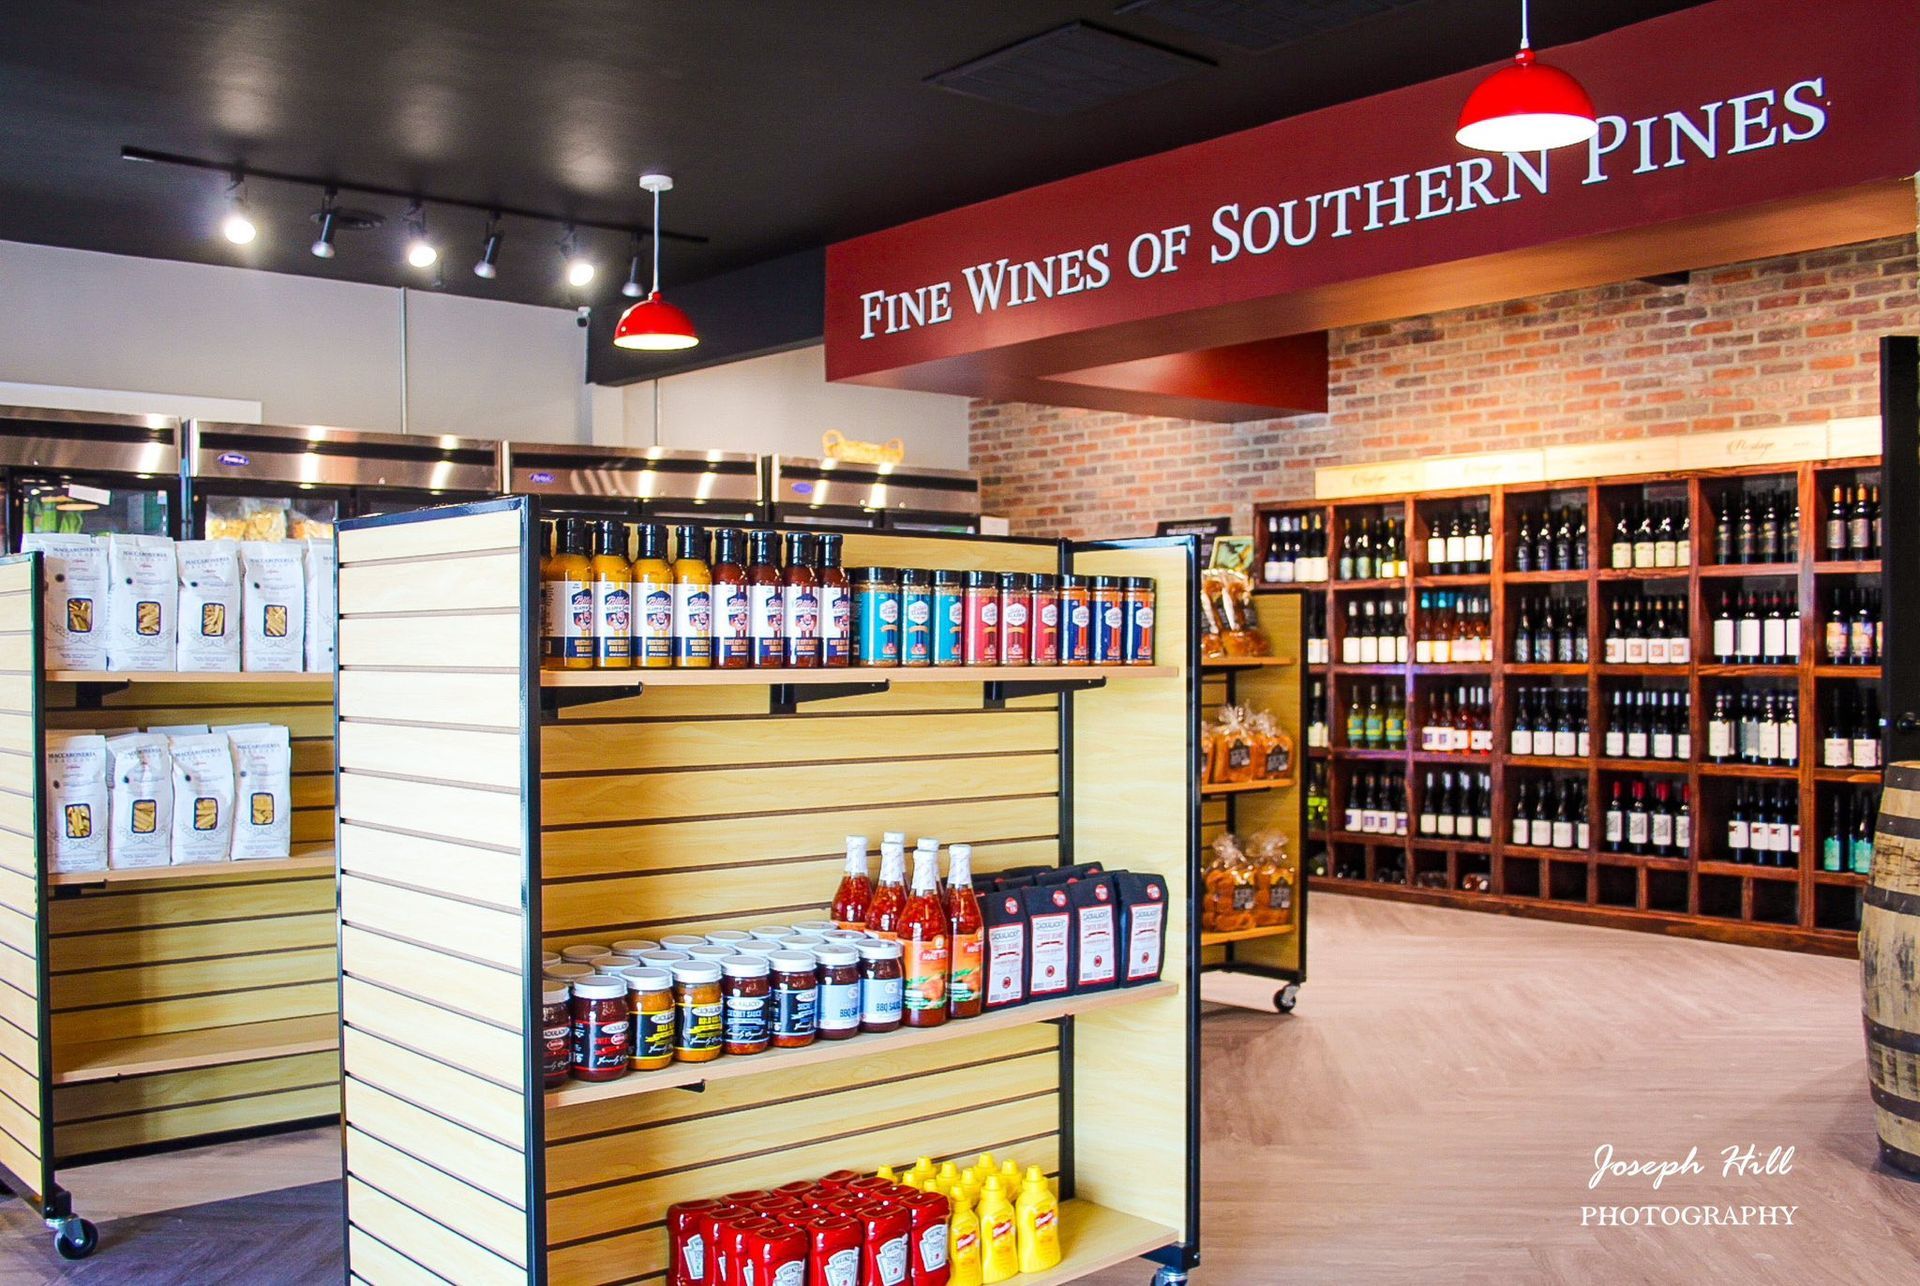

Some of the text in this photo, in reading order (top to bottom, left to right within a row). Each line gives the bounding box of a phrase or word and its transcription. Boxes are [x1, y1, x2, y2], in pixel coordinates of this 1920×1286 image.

[860, 77, 1826, 340] FINE WINES OF SOUTHERN PINES
[876, 1002, 889, 1013] BBQ
